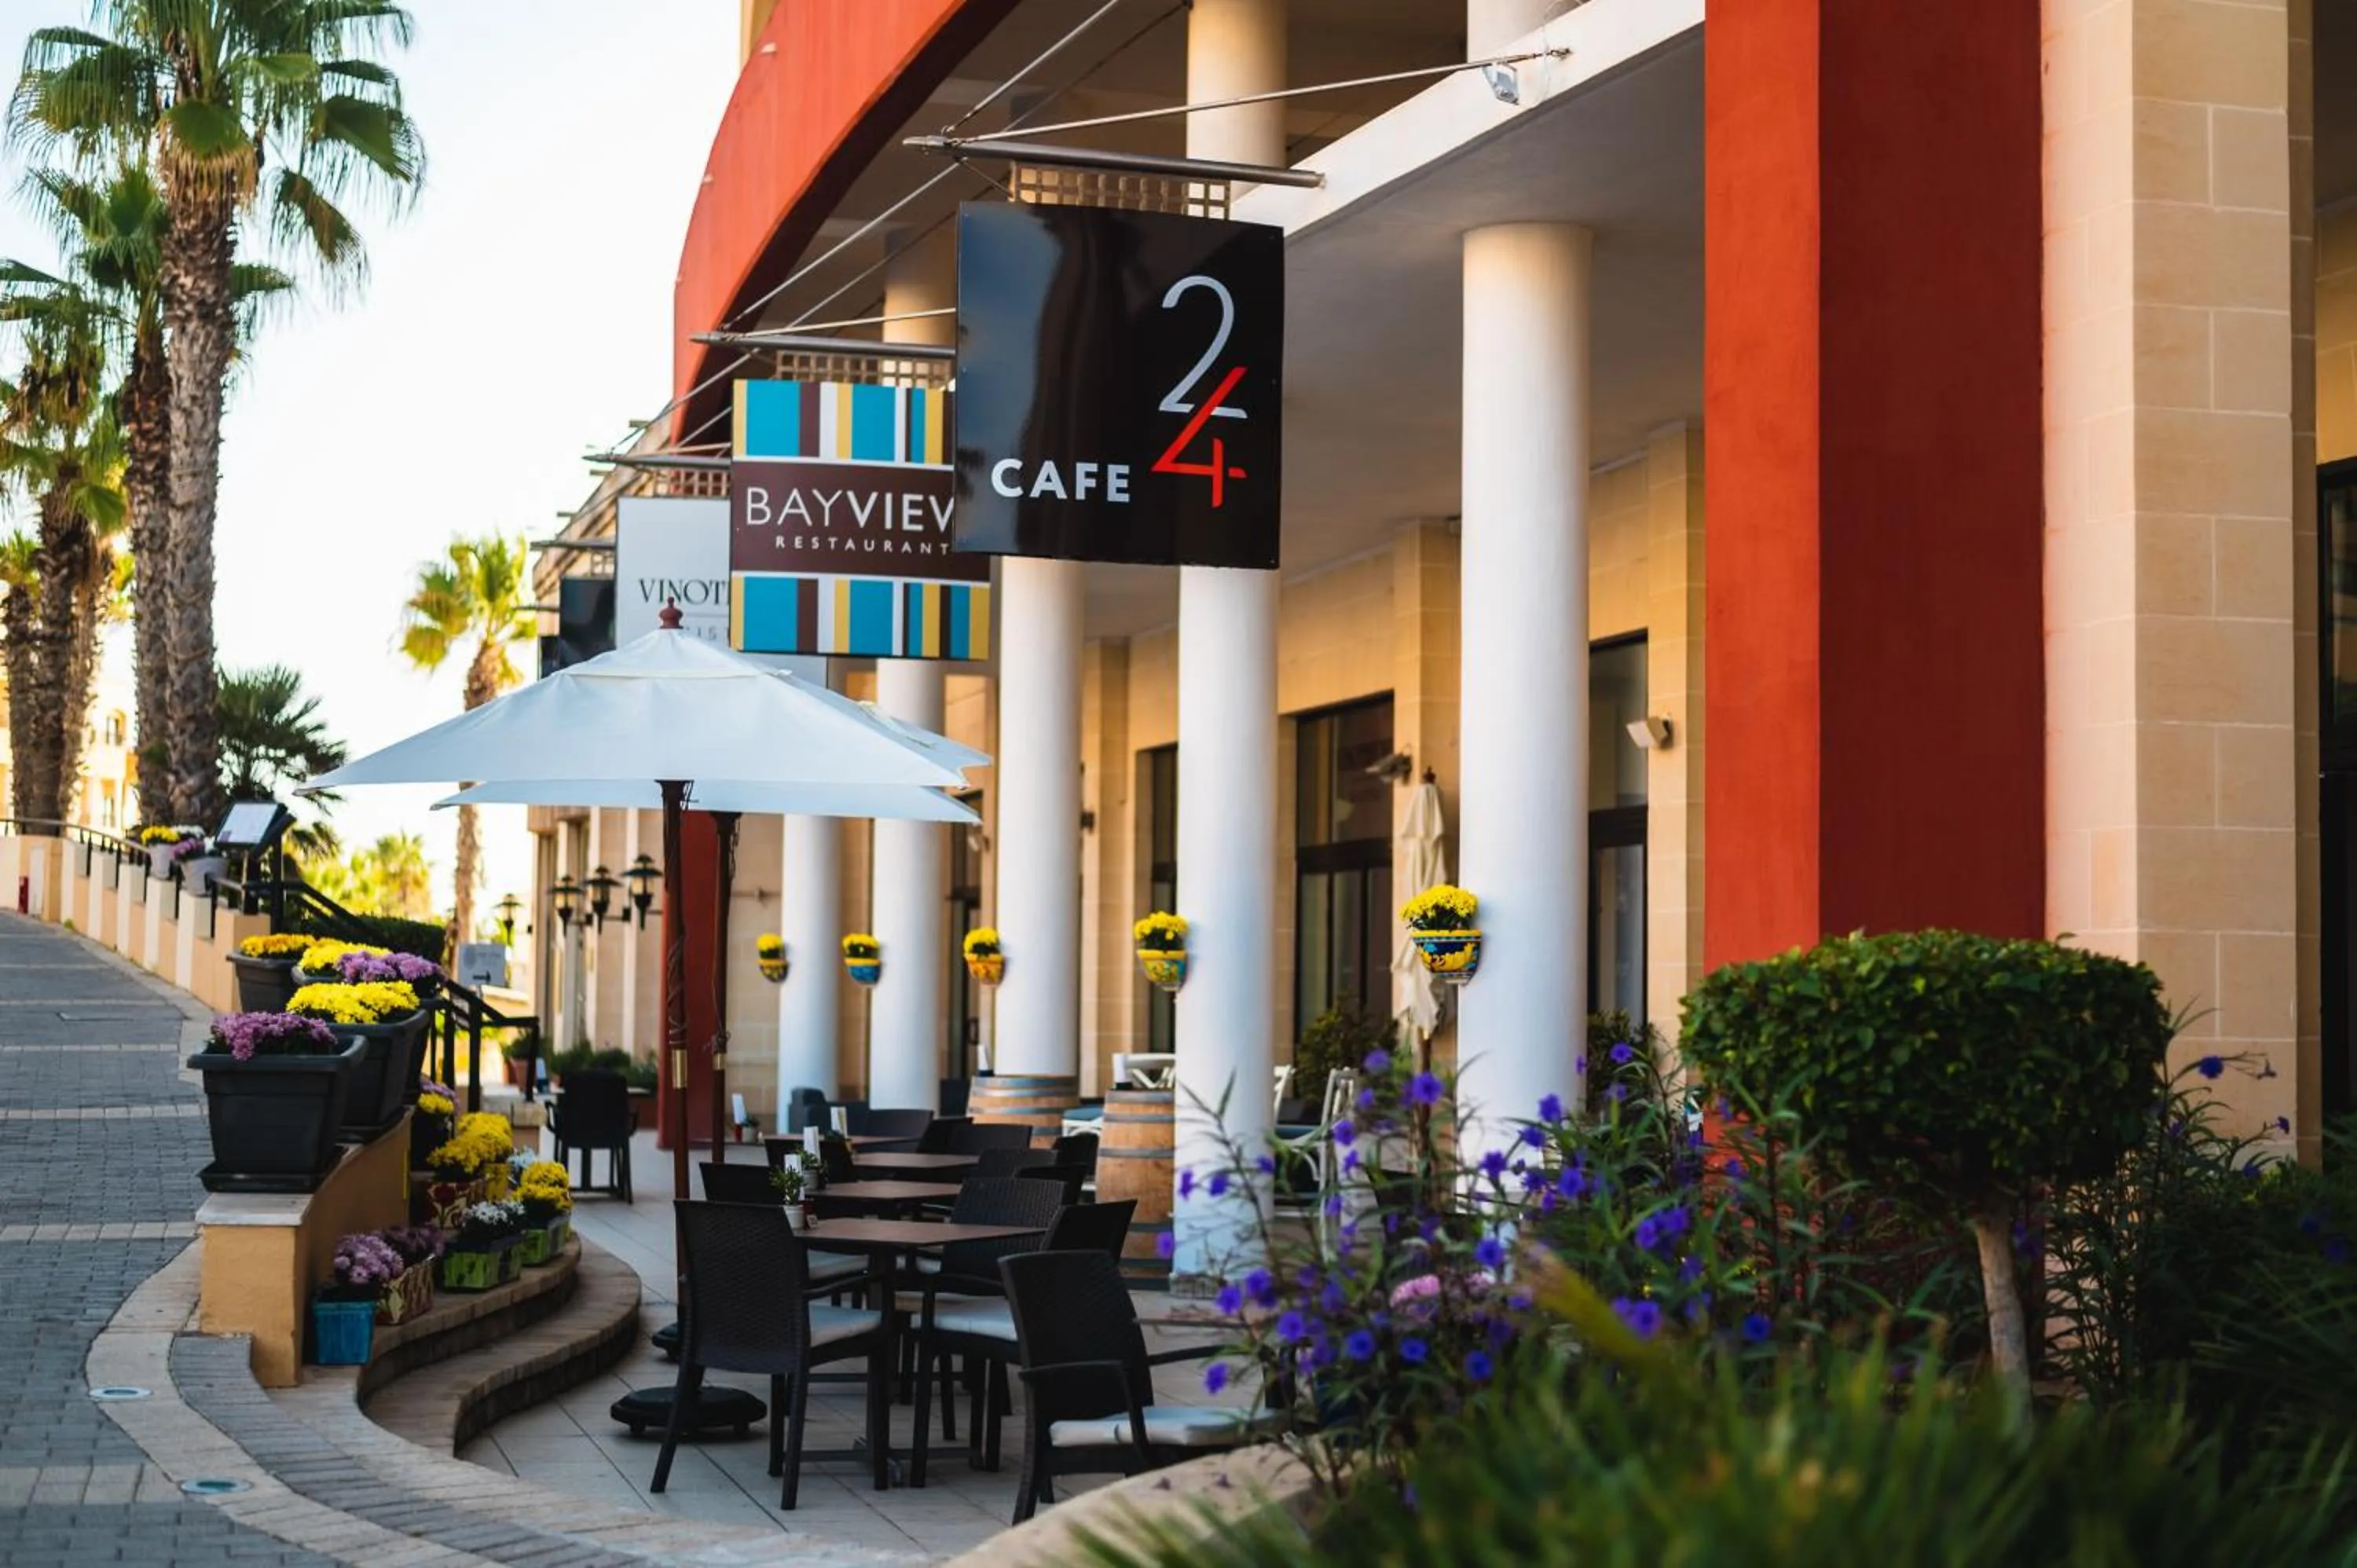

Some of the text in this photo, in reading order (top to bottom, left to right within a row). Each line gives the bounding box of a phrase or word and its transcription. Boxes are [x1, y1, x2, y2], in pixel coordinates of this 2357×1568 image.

[991, 458, 1131, 503] CAFE
[775, 536, 949, 555] RESTAURANT
[639, 578, 730, 606] VINOT
